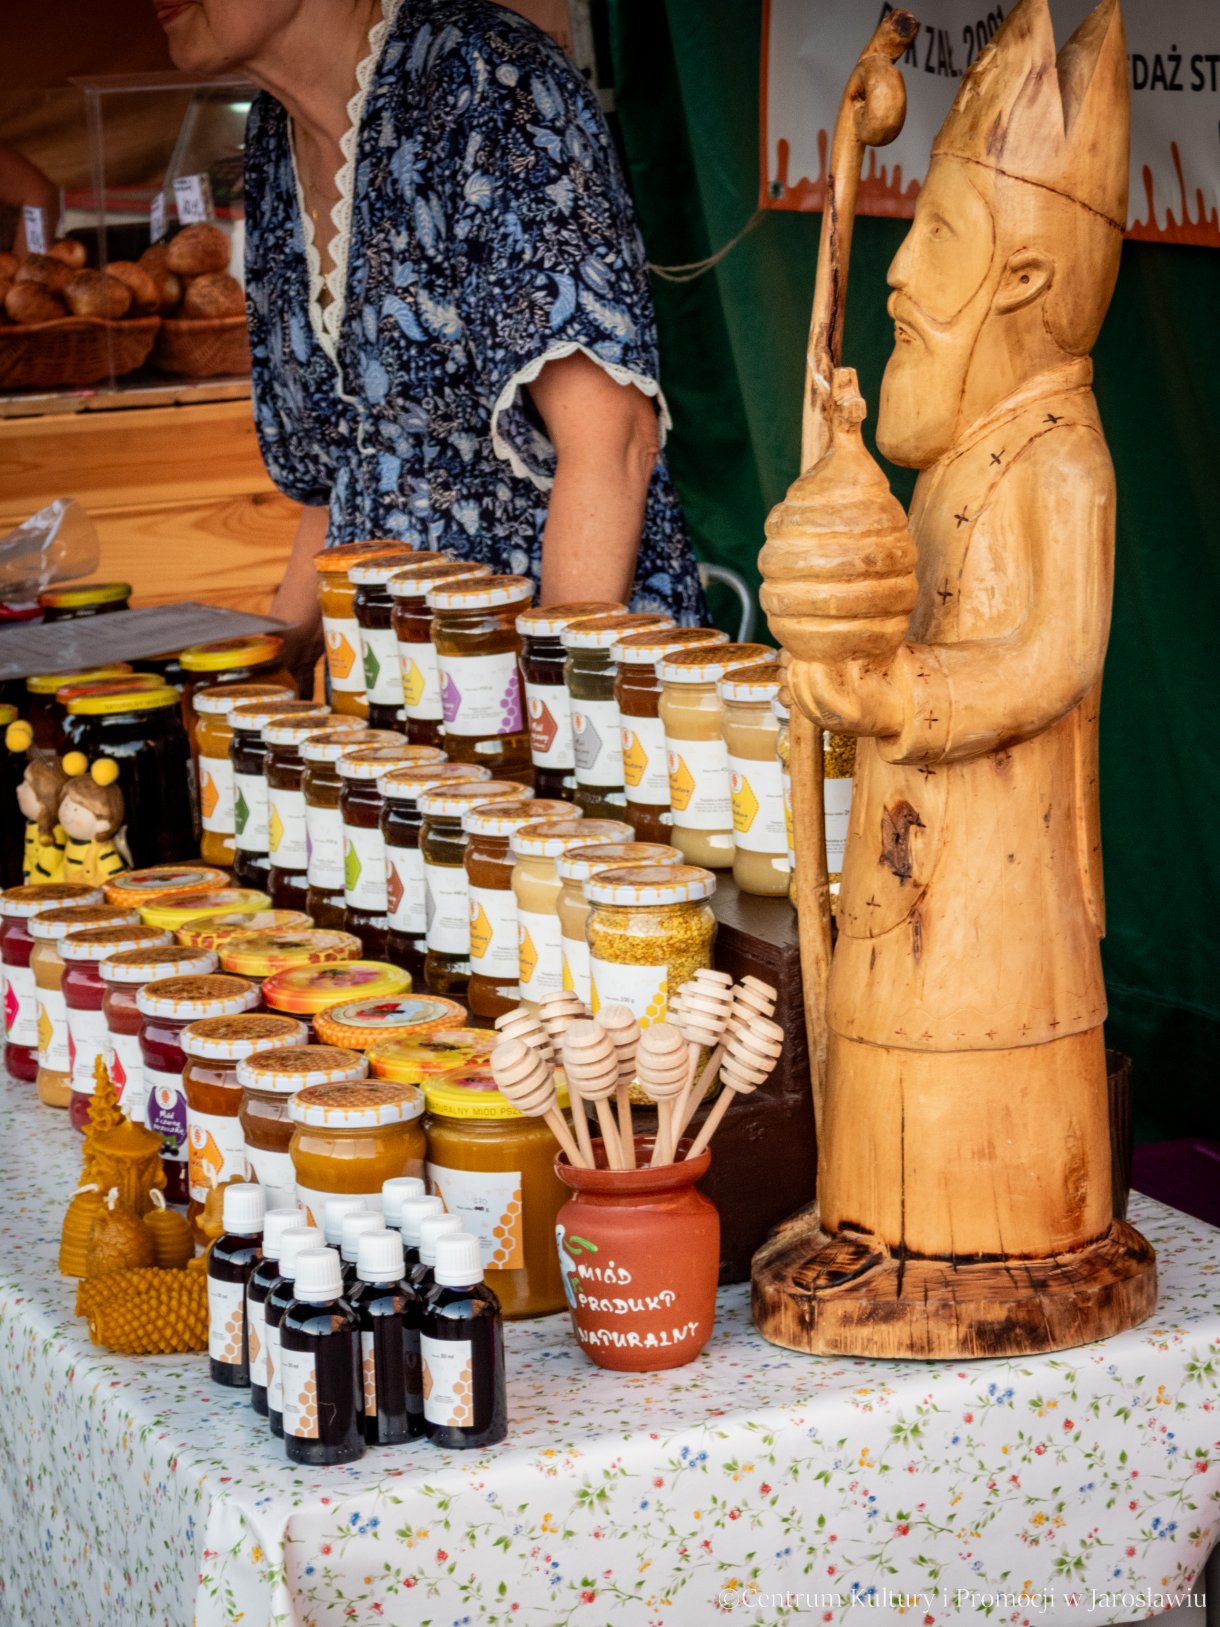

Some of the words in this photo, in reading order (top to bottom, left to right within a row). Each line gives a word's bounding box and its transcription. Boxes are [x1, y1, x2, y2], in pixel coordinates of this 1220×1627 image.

[924, 25, 963, 77] ZAŁ.
[1127, 43, 1184, 91] DAŻ
[577, 1260, 632, 1285] MIÓD
[578, 1290, 676, 1314] PRODUKT
[577, 1321, 699, 1348] NATURALNY
